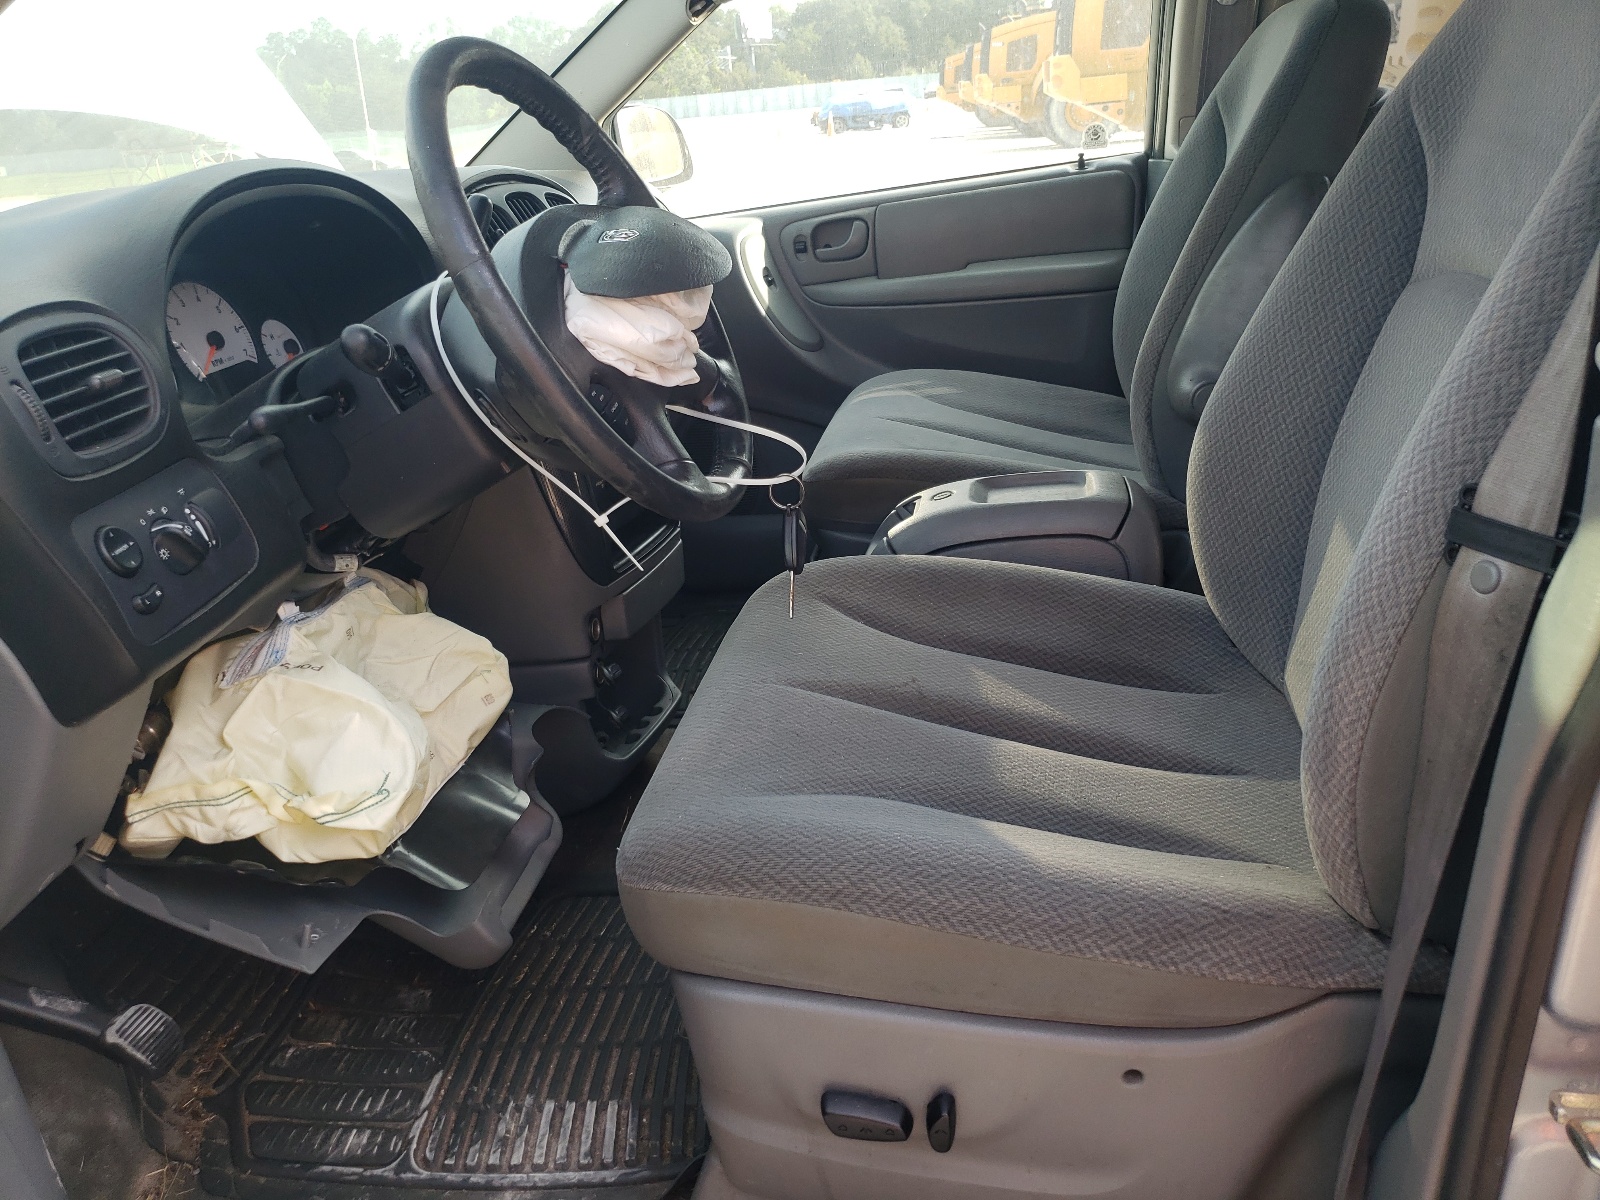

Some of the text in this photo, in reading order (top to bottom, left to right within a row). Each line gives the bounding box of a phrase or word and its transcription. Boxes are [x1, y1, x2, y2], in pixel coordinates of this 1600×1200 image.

[216, 306, 222, 314] 5
[174, 317, 181, 326] 2
[234, 325, 240, 333] 6
[243, 348, 249, 357] 7
[211, 357, 223, 367] RPM
